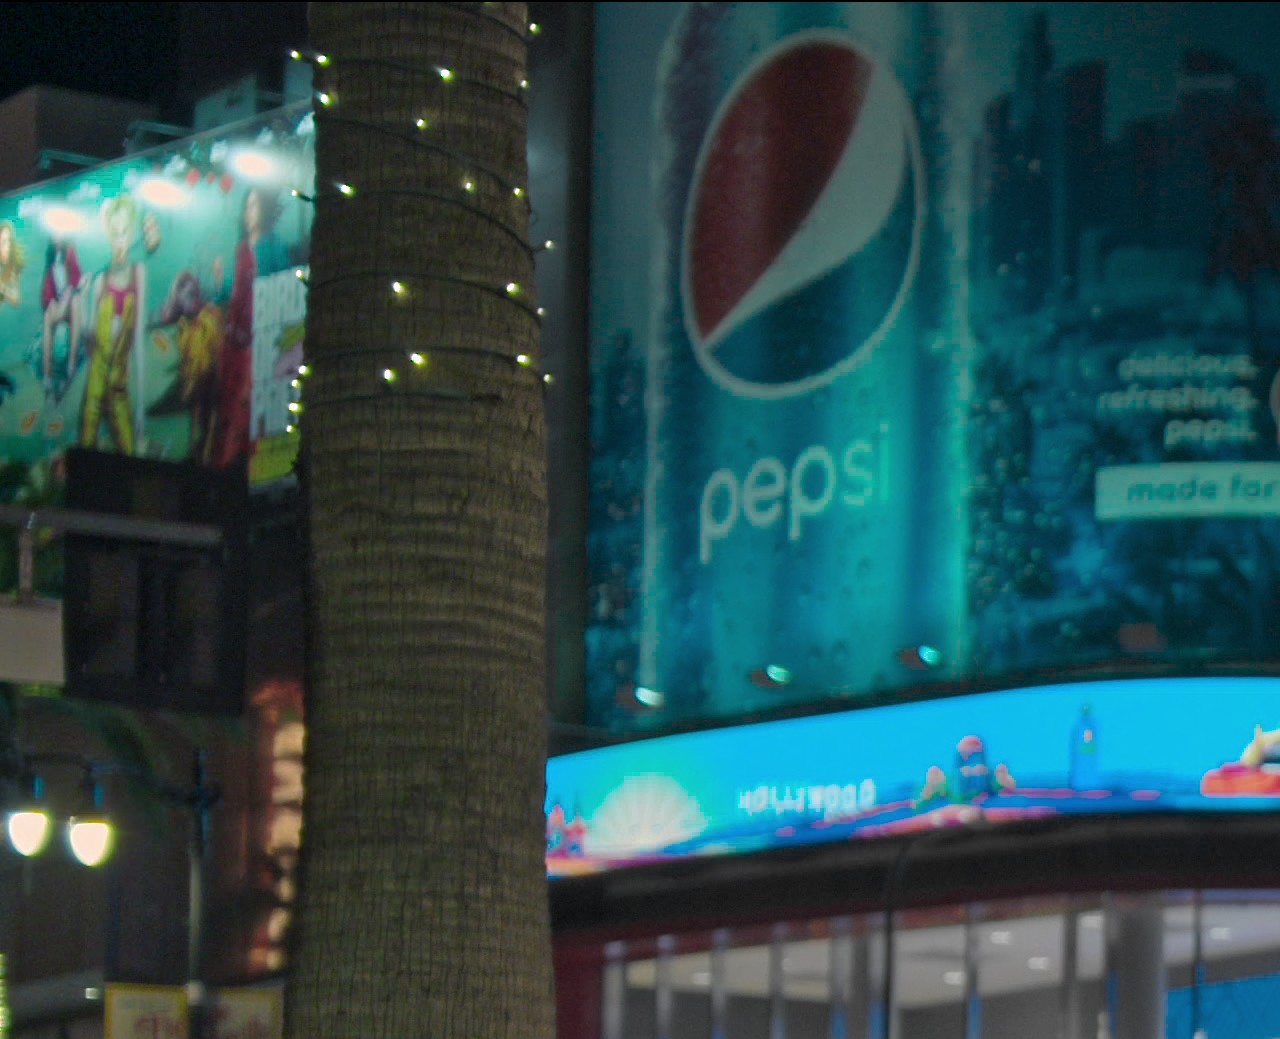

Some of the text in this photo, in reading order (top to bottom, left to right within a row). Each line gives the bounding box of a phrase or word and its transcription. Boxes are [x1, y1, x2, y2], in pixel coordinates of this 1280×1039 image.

[699, 423, 890, 565] pepsi
[1127, 479, 1217, 502] made
[1231, 475, 1280, 500] for
